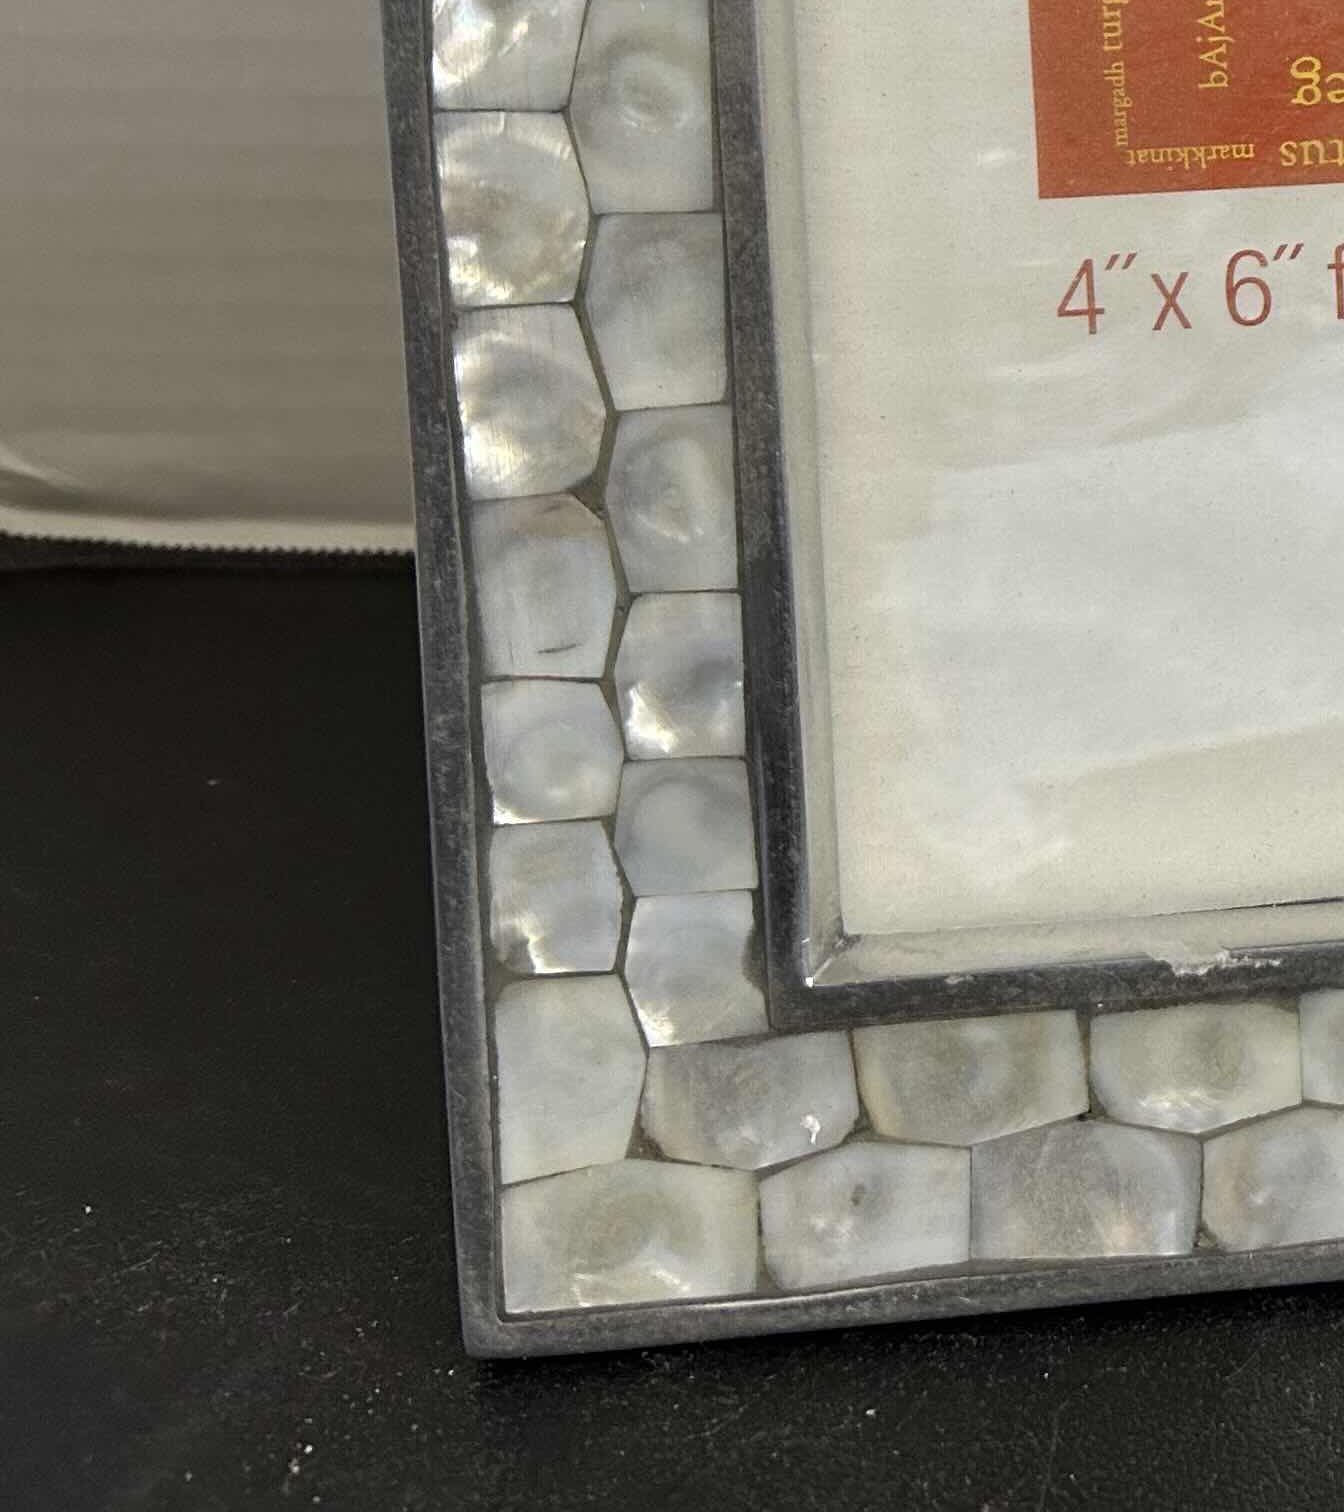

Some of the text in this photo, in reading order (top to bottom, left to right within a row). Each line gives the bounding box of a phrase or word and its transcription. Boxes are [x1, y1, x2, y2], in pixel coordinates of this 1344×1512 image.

[1105, 61, 1132, 147] margadh
[1124, 142, 1255, 170] markkinat
[1150, 271, 1193, 332] x
